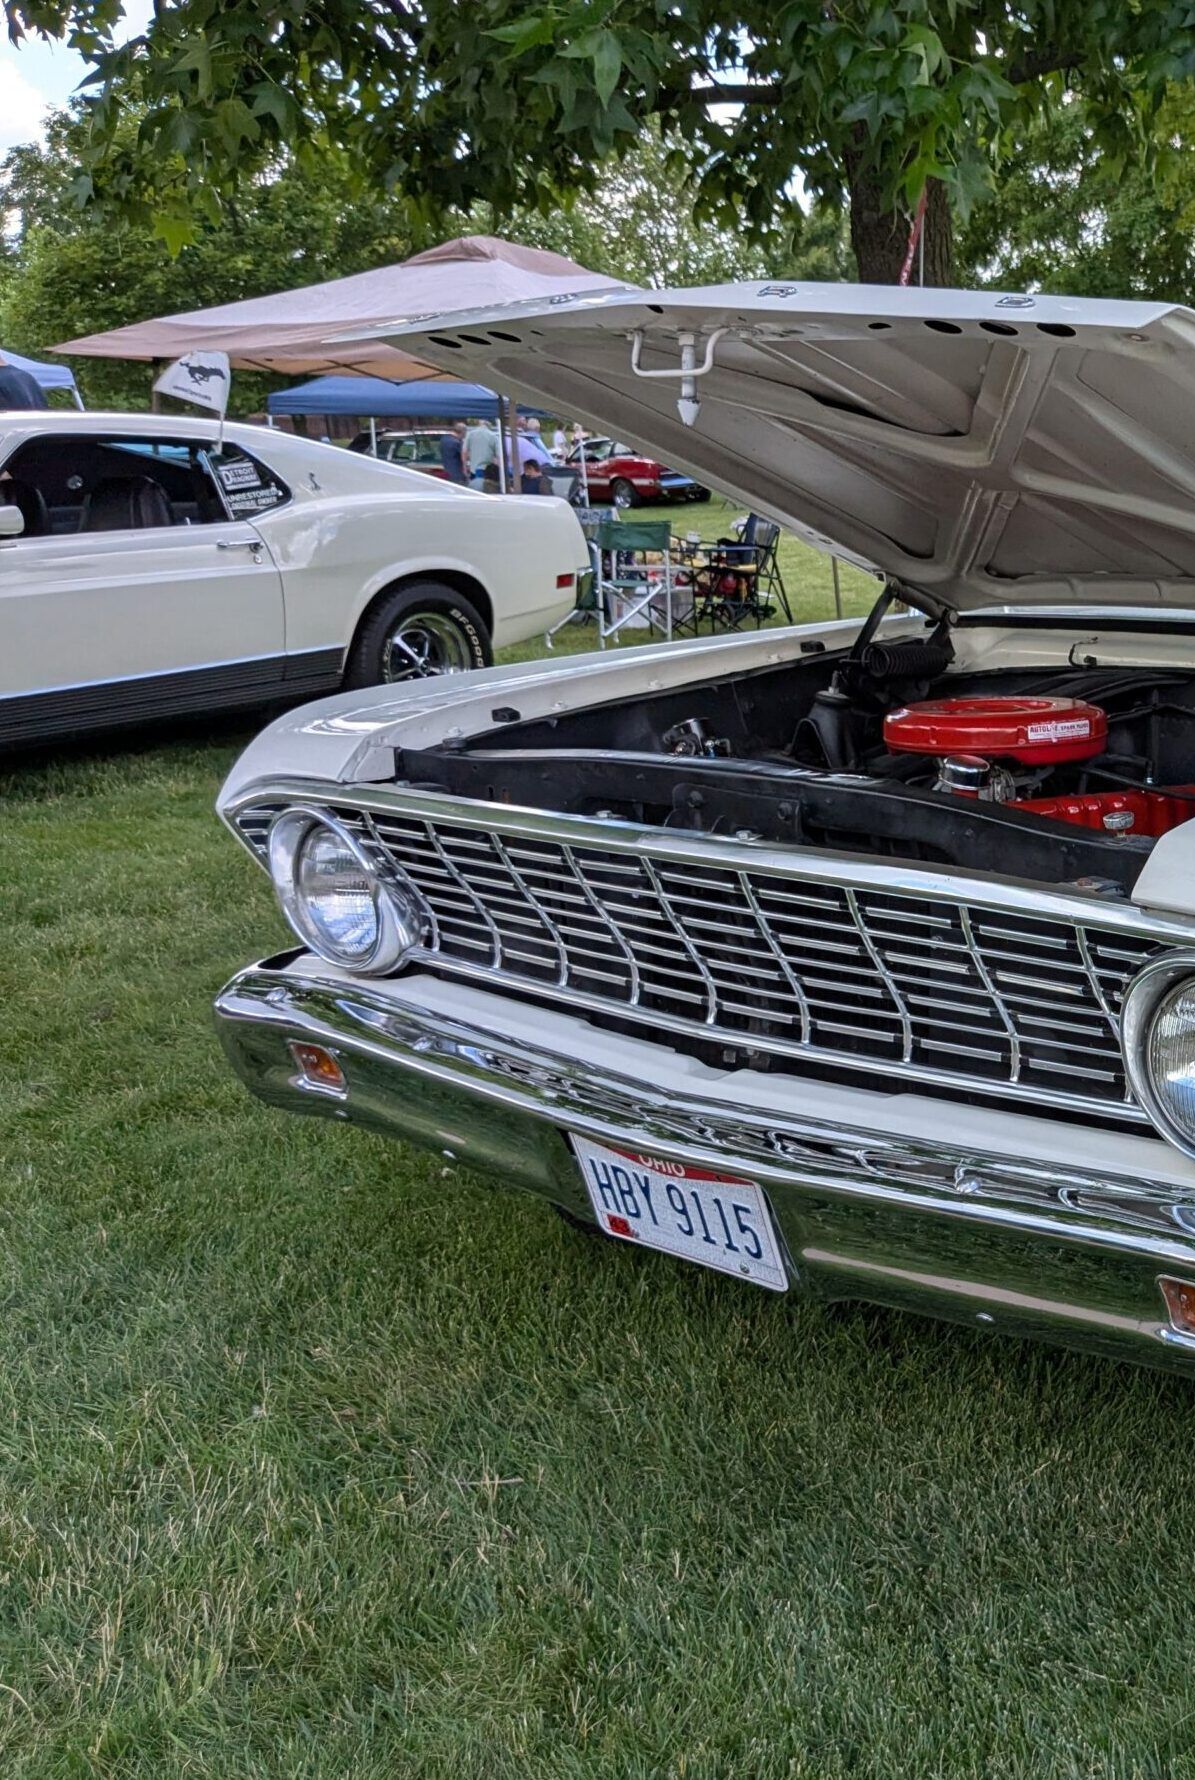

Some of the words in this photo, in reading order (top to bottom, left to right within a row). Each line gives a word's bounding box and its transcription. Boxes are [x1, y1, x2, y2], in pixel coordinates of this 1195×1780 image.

[638, 1154, 686, 1177] OHIO
[589, 1157, 659, 1226] HBY
[665, 1183, 763, 1260] 9115
